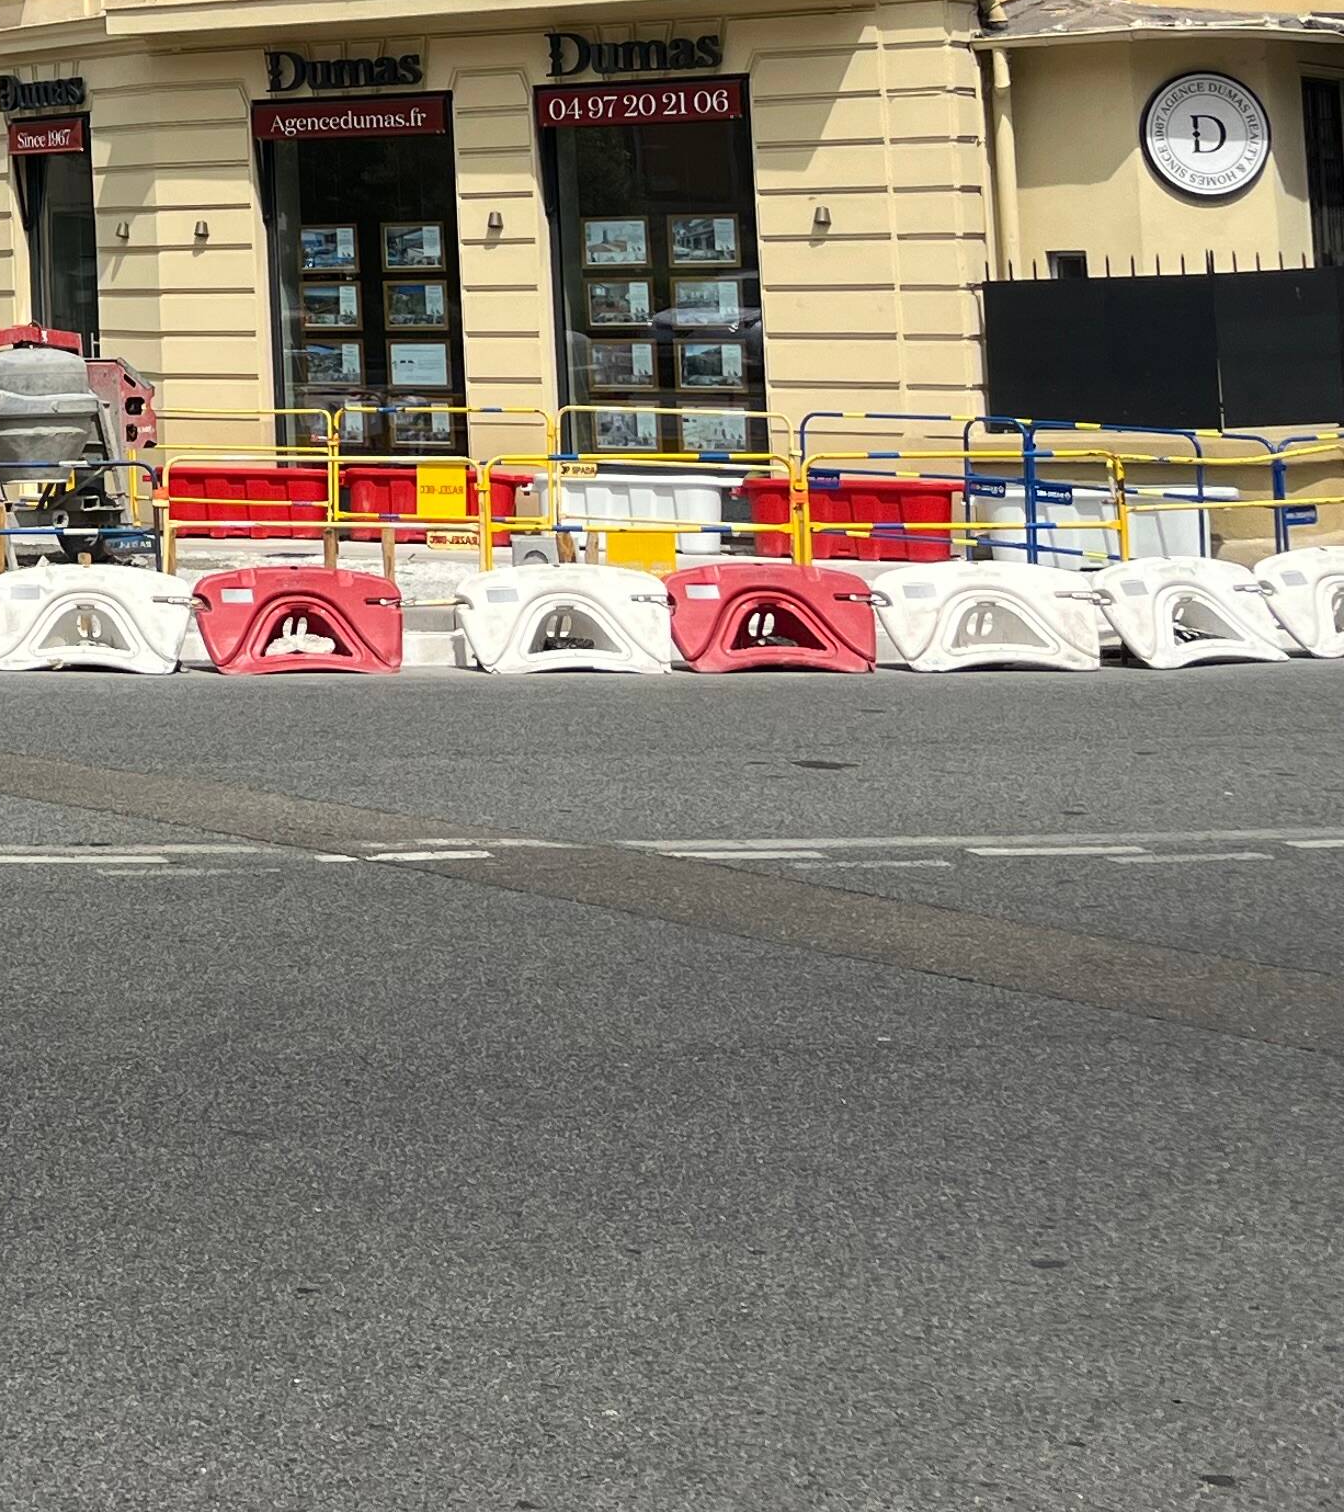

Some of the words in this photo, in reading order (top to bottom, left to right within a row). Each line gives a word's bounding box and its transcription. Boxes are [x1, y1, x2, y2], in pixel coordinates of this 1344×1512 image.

[544, 33, 723, 77] Dumas
[264, 51, 423, 92] Dumas
[548, 97, 583, 120] 04
[587, 95, 618, 118] 97
[623, 93, 657, 117] 20
[662, 91, 688, 115] 21
[693, 89, 729, 113] 06
[1160, 82, 1205, 115] AGENCE
[1208, 82, 1251, 114] DUMAS
[270, 106, 427, 136] Agencedumas.fr
[1189, 114, 1227, 154] D
[17, 132, 47, 149] Since
[47, 128, 72, 146] 1967
[1157, 144, 1189, 178] SINCE
[1189, 169, 1238, 187] HOMES
